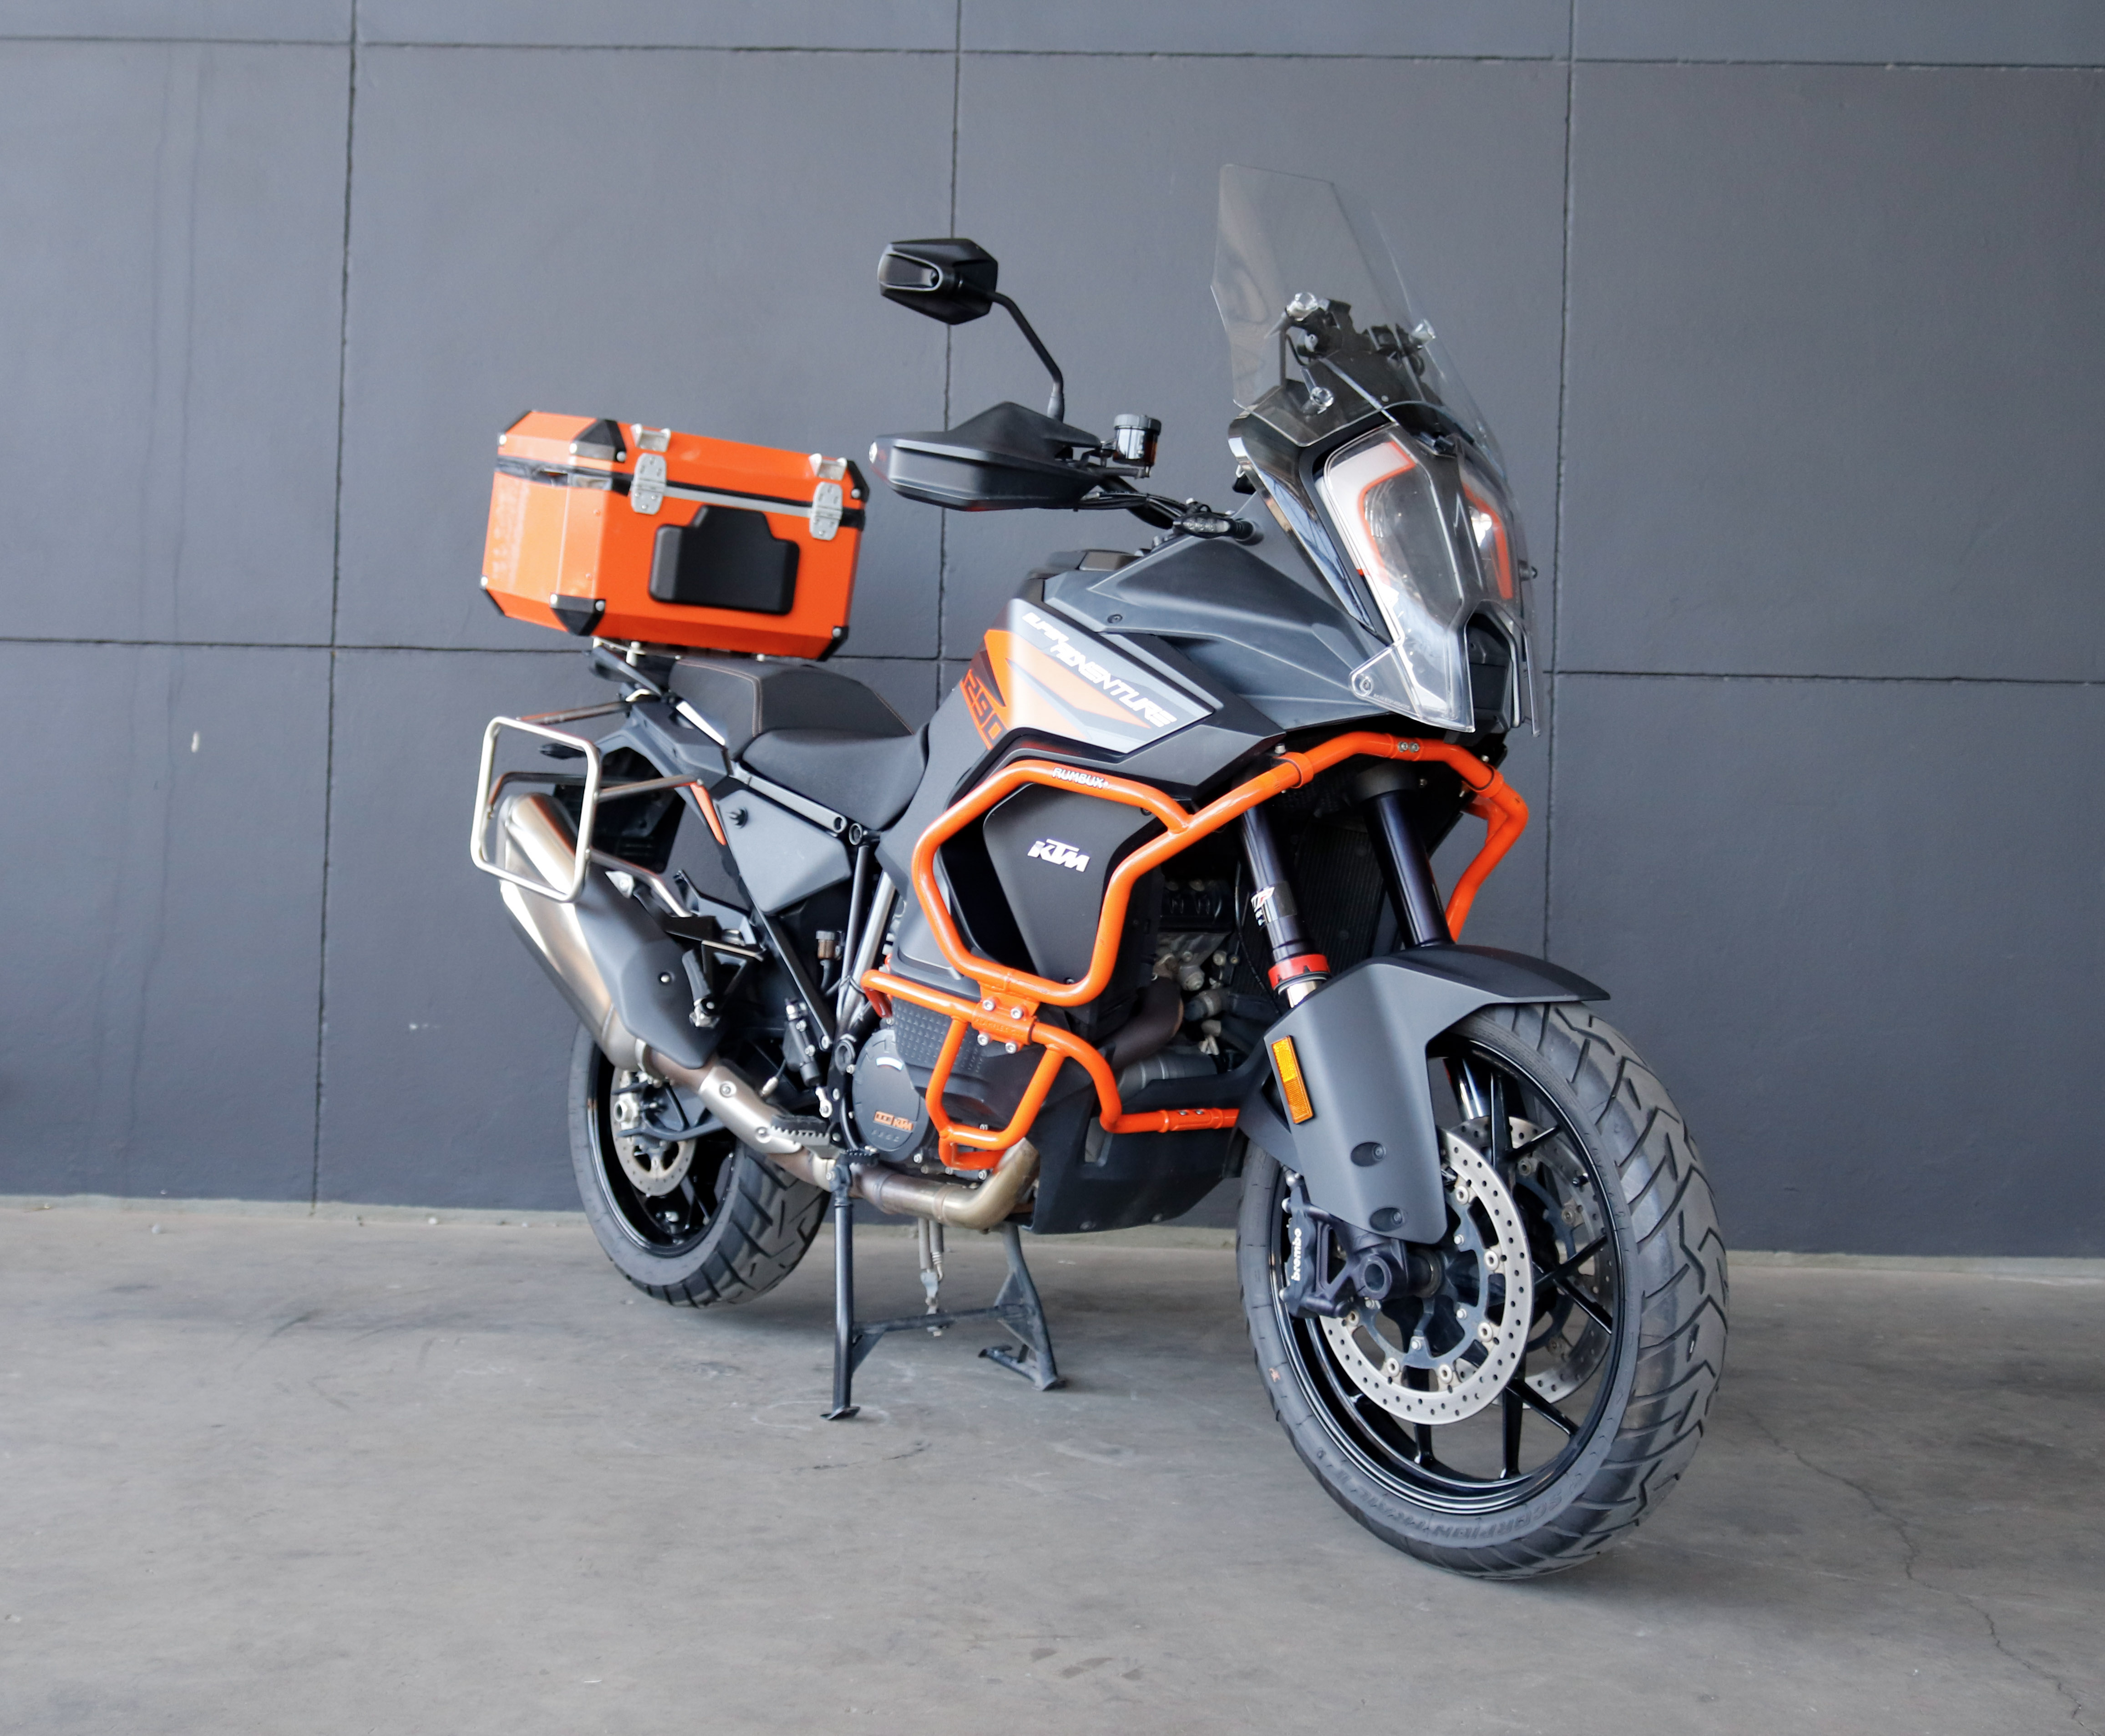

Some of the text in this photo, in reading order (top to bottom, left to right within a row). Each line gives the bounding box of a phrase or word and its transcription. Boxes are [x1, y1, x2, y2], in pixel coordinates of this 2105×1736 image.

[1050, 642, 1177, 728] ADVENTURE
[1052, 767, 1105, 789] RUMBUX
[1027, 838, 1091, 873] KTM
[1291, 1228, 1302, 1281] brembo
